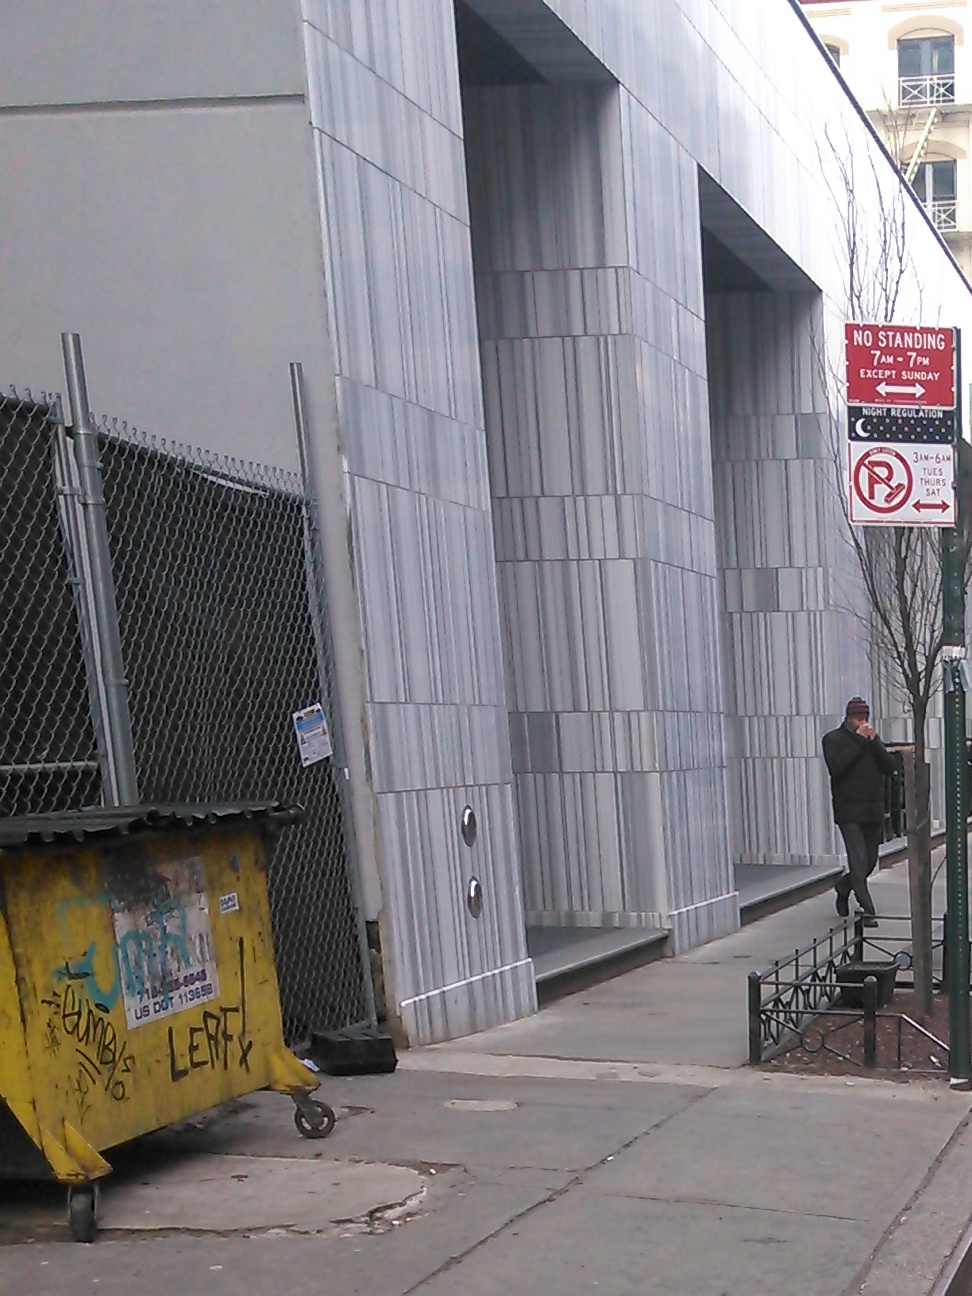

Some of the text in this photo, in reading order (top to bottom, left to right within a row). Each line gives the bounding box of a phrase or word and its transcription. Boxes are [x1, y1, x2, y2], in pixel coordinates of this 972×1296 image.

[853, 330, 945, 350] NO STANDING
[871, 350, 894, 366] 7AM
[907, 352, 930, 367] 7PM
[860, 369, 940, 381] EXCEPT SUNDAY
[862, 407, 943, 418] NIGHT REGULATION
[922, 467, 944, 477] TUES
[919, 477, 946, 487] THURS
[925, 488, 941, 497] SAT
[134, 1005, 150, 1020] US
